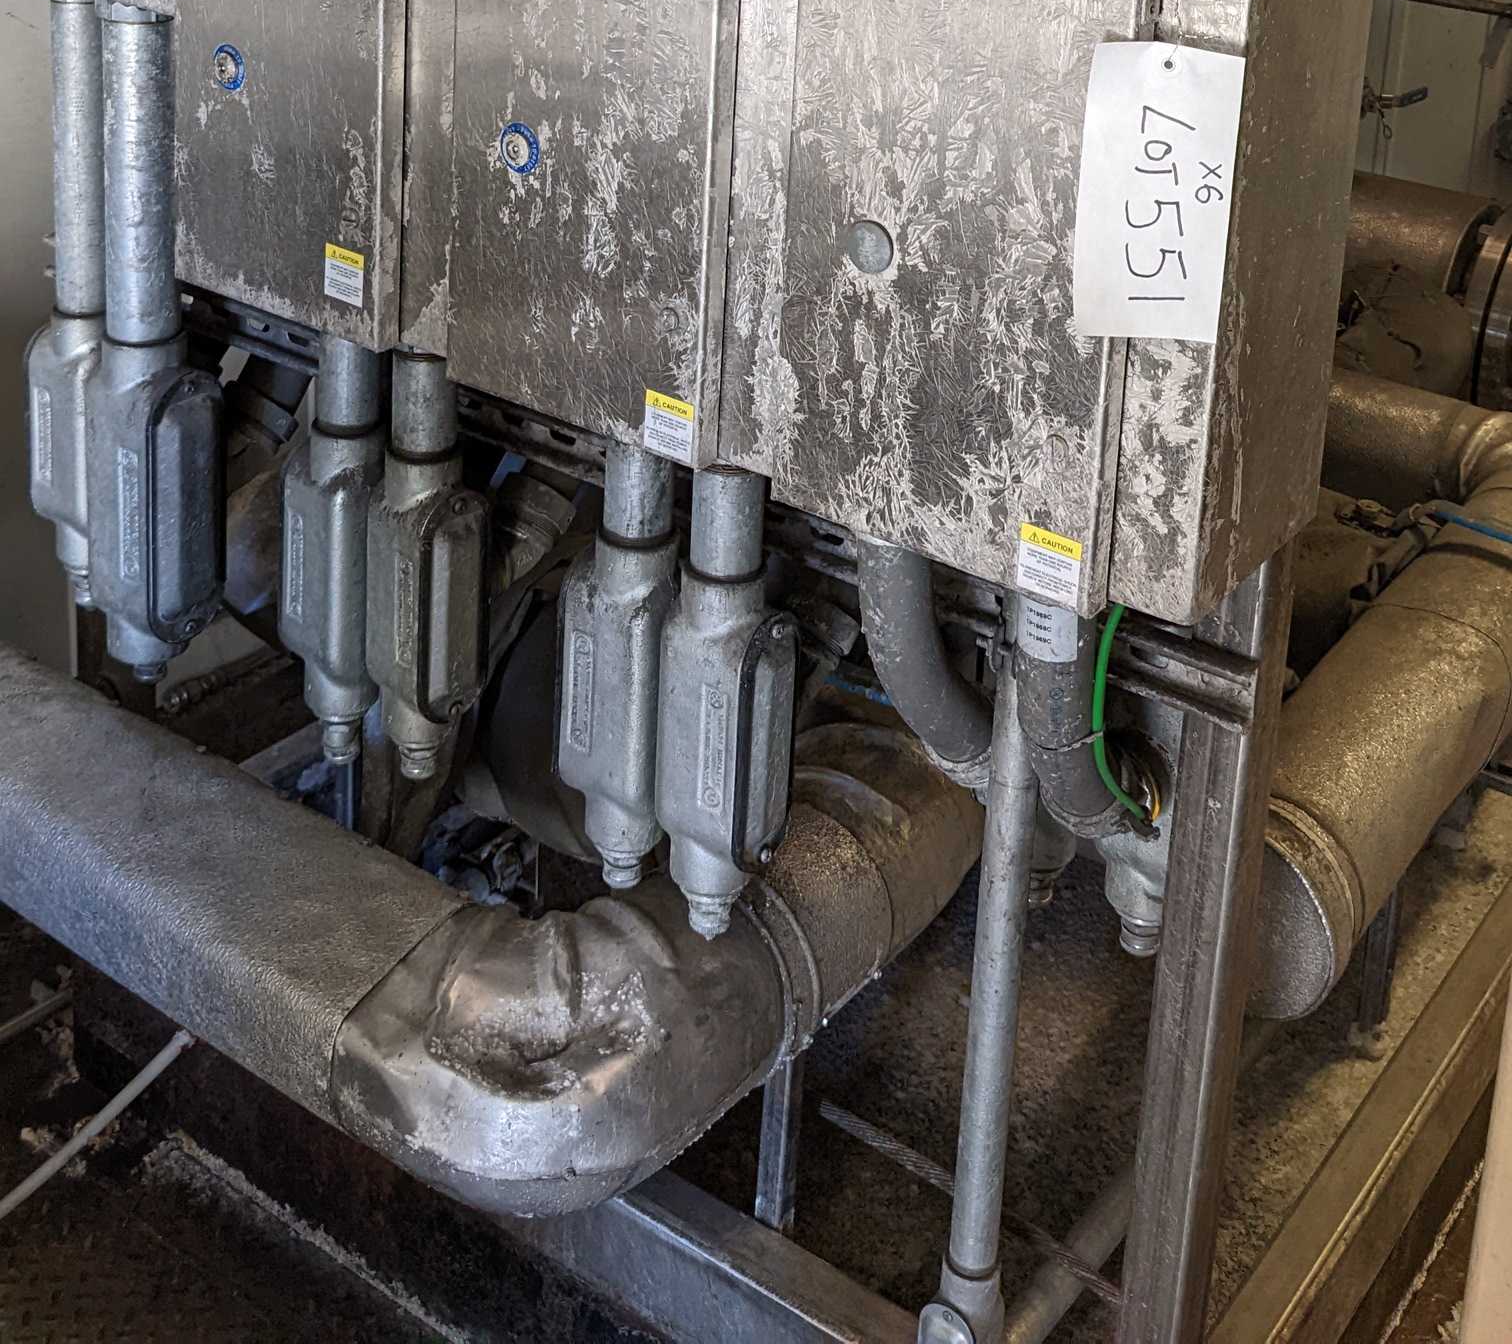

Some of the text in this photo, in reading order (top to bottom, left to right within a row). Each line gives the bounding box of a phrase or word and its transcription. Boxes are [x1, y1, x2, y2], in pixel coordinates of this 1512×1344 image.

[1125, 105, 1196, 301] LOT 551
[662, 402, 687, 415] CAUTION
[1041, 537, 1073, 554] CAUTION
